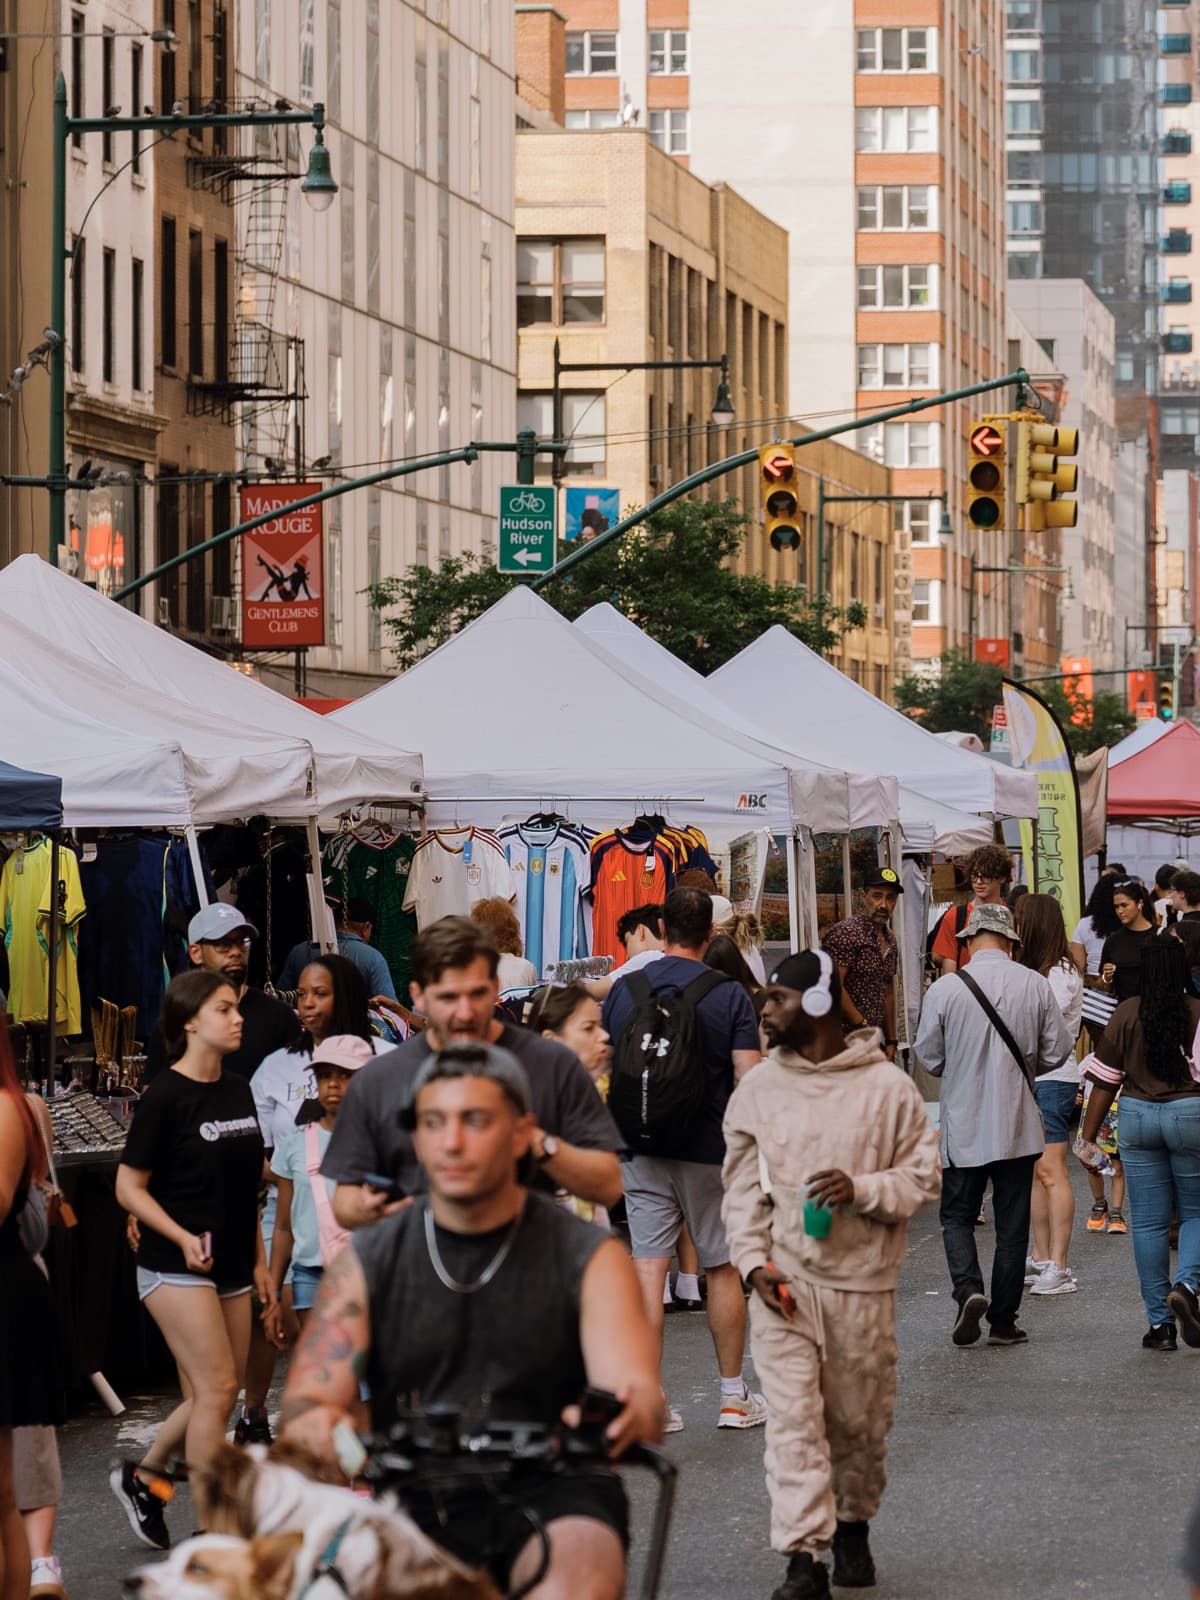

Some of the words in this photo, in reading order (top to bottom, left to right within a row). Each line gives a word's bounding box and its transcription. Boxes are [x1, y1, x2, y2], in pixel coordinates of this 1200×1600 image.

[246, 497, 317, 516] MADE
[502, 517, 552, 530] Hudson
[510, 532, 544, 544] River
[248, 607, 319, 620] GENTLEMENS
[268, 620, 299, 633] CLUB
[737, 793, 767, 808] ABC
